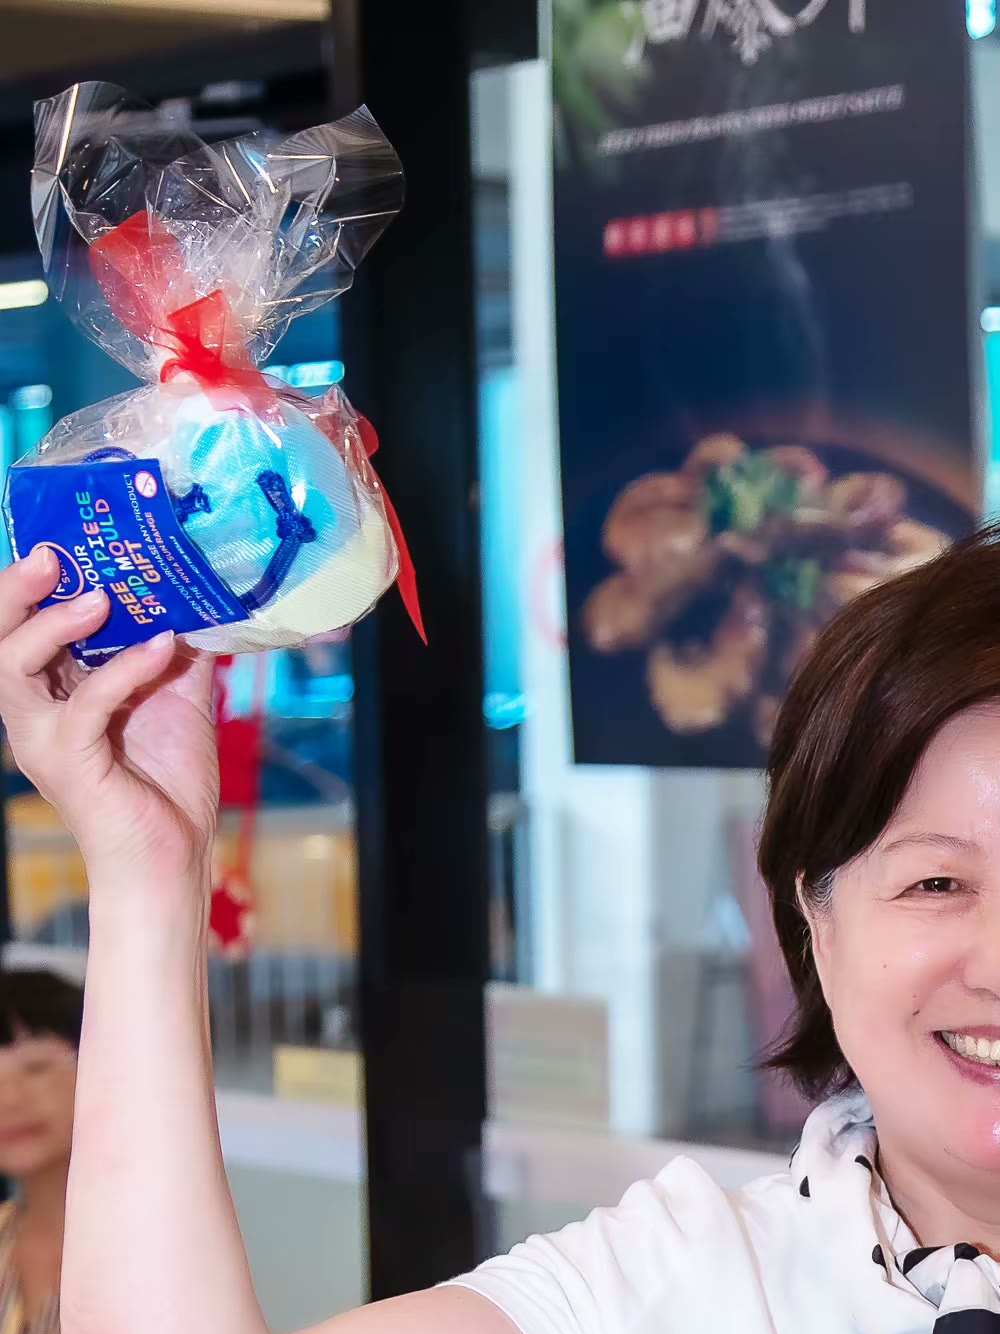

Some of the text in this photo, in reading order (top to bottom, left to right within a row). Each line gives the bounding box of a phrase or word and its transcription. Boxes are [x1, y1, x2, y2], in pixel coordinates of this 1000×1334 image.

[74, 545, 105, 591] YOUR
[75, 491, 153, 625] FREE 4 PIECE
[95, 498, 168, 615] SAND MOULD
[123, 473, 209, 621] WHEN YOU PURCHASE ANY PRODUCT
[123, 539, 162, 583] GIFT
[144, 511, 221, 619] FROM THE NIVEA SUN RANGE
